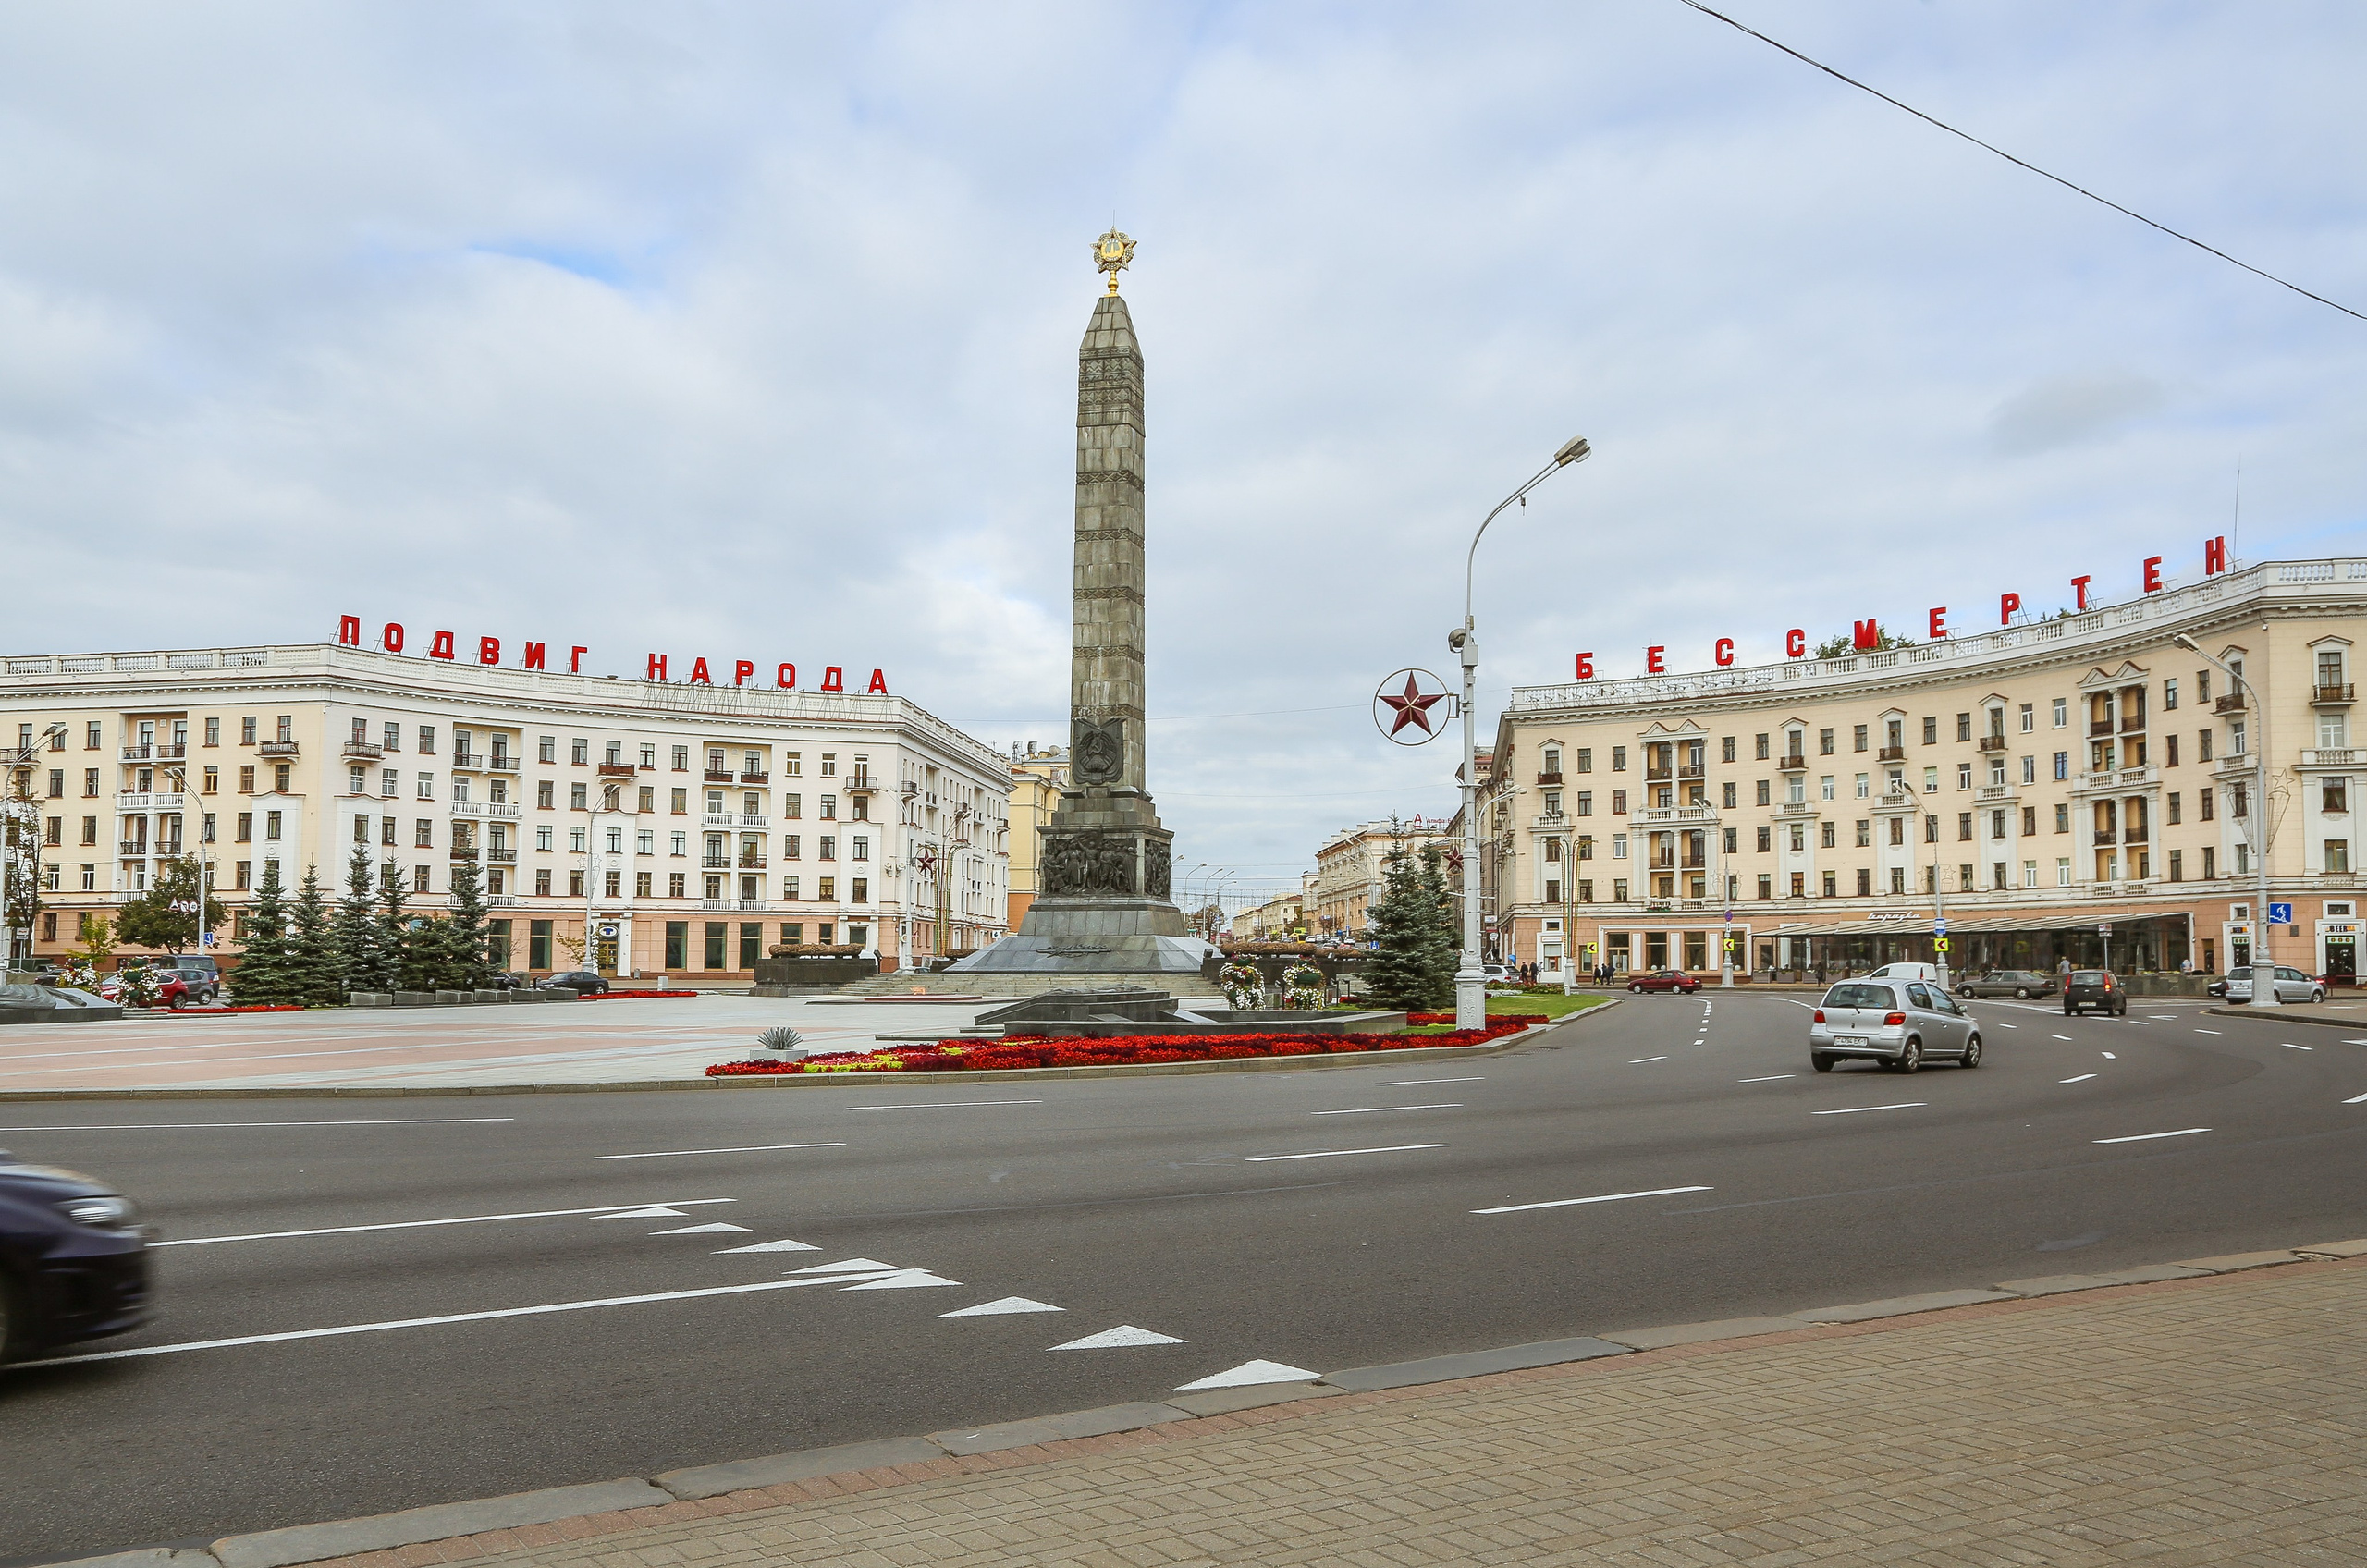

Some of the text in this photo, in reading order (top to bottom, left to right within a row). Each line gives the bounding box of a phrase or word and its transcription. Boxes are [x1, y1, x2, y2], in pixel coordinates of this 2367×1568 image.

[340, 615, 888, 694] ПОДВИГ НАРОДА
[1576, 536, 2225, 680] БЕССМЕРТЕН
